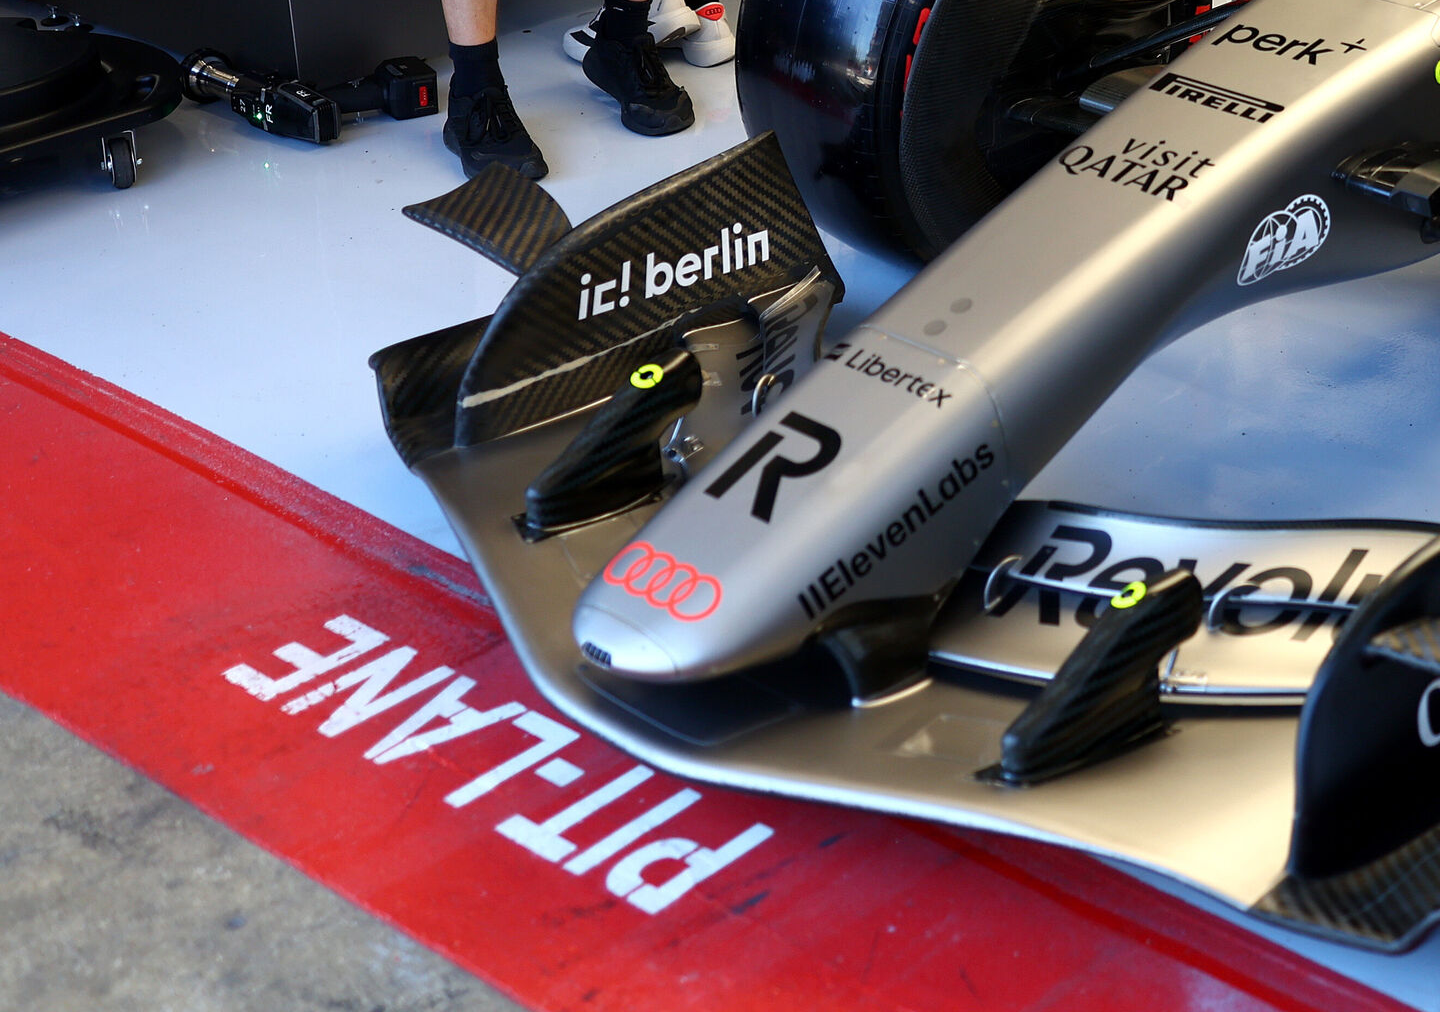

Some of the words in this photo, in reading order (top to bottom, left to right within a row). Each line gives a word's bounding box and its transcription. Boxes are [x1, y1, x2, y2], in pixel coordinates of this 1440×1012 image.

[264, 103, 274, 125] FR
[1149, 72, 1285, 123] PIRELLI
[1058, 145, 1189, 201] QATAR
[1122, 138, 1215, 178] visit
[644, 222, 770, 299] berlin
[844, 349, 953, 409] Libertex
[221, 613, 775, 916] PIT-LANE
